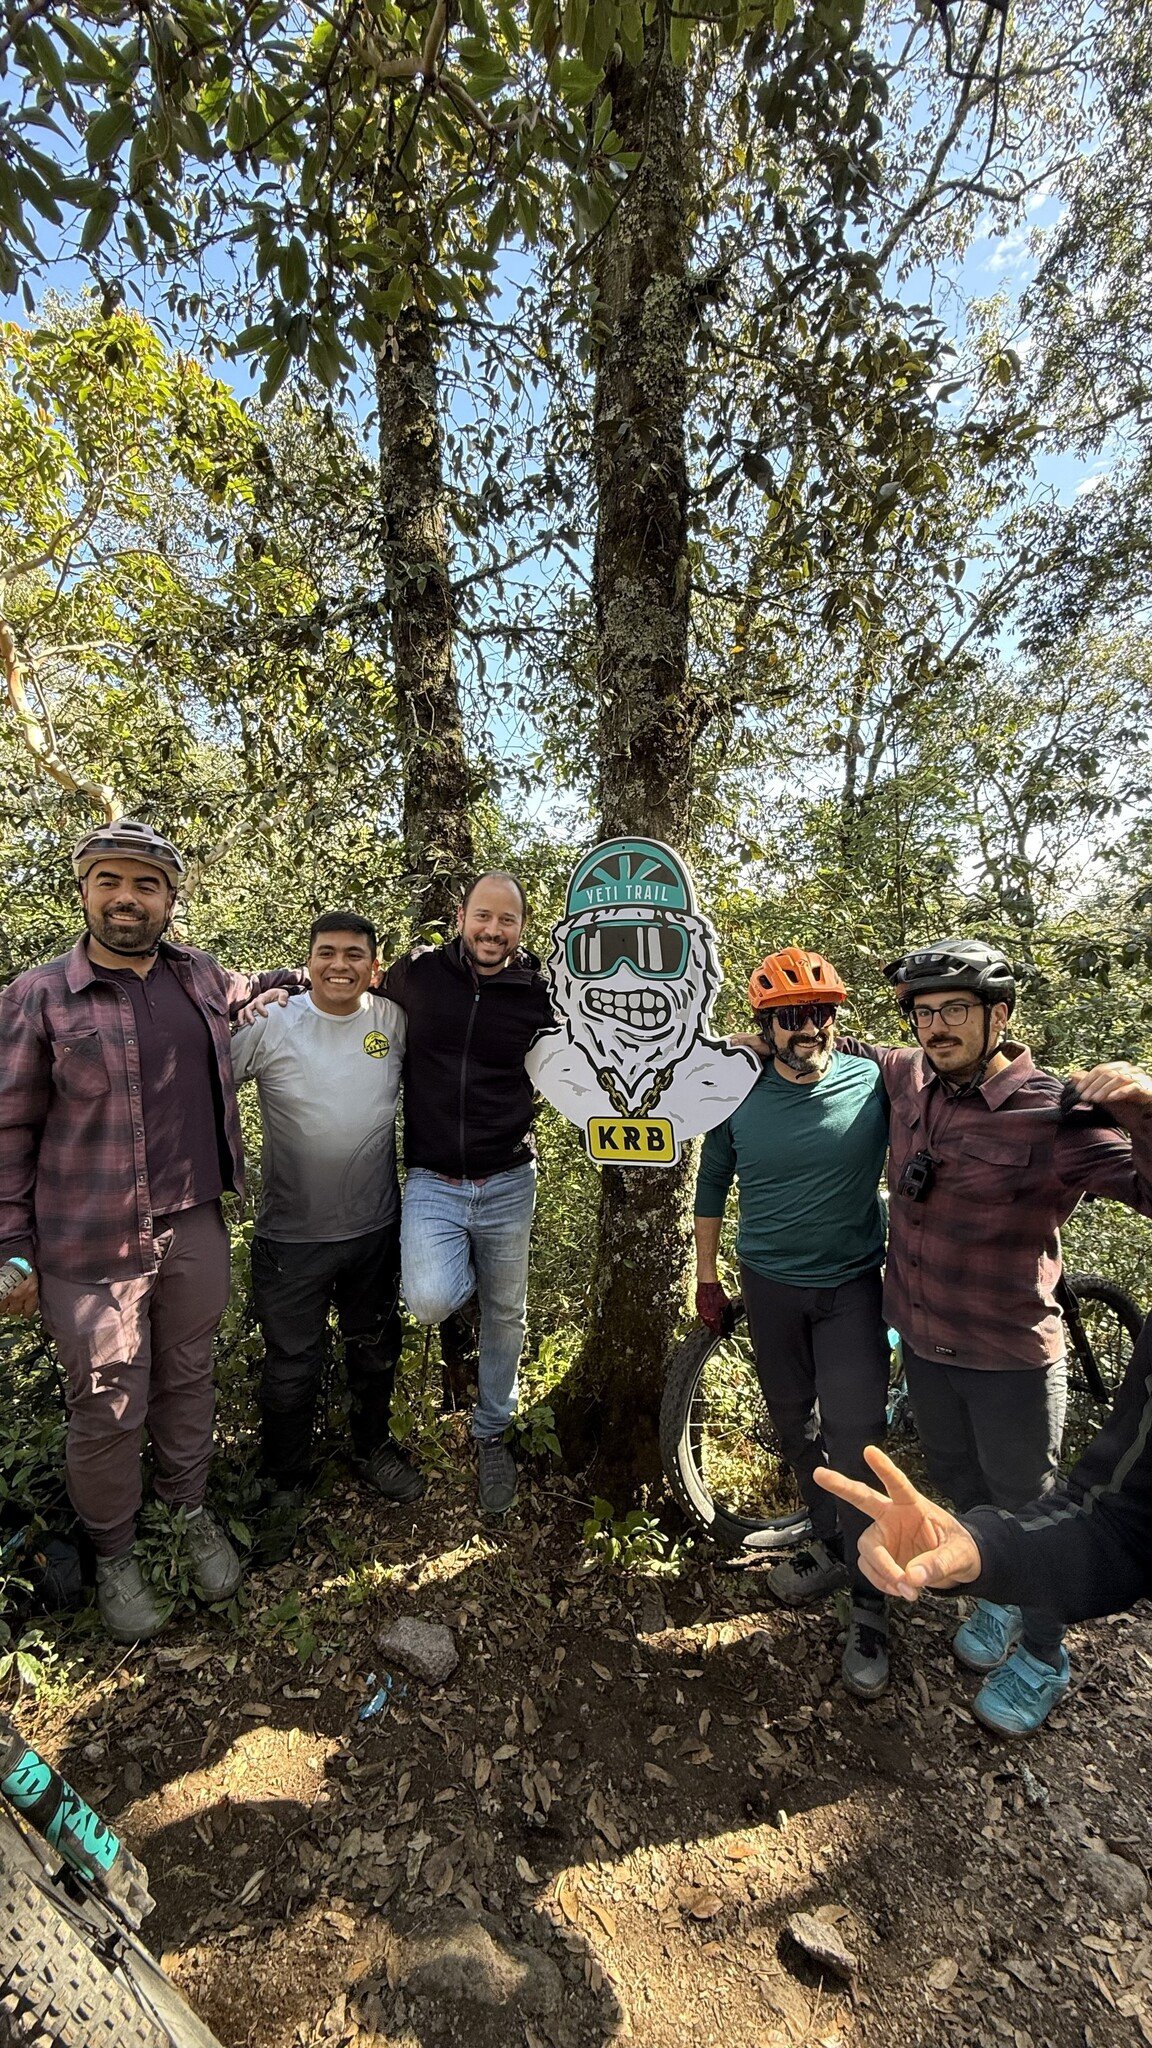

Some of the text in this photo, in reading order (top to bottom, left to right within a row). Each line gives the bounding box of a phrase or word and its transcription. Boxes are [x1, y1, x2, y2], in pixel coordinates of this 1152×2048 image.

[586, 884, 669, 904] YETI TRAIL
[598, 1125, 666, 1151] KRB
